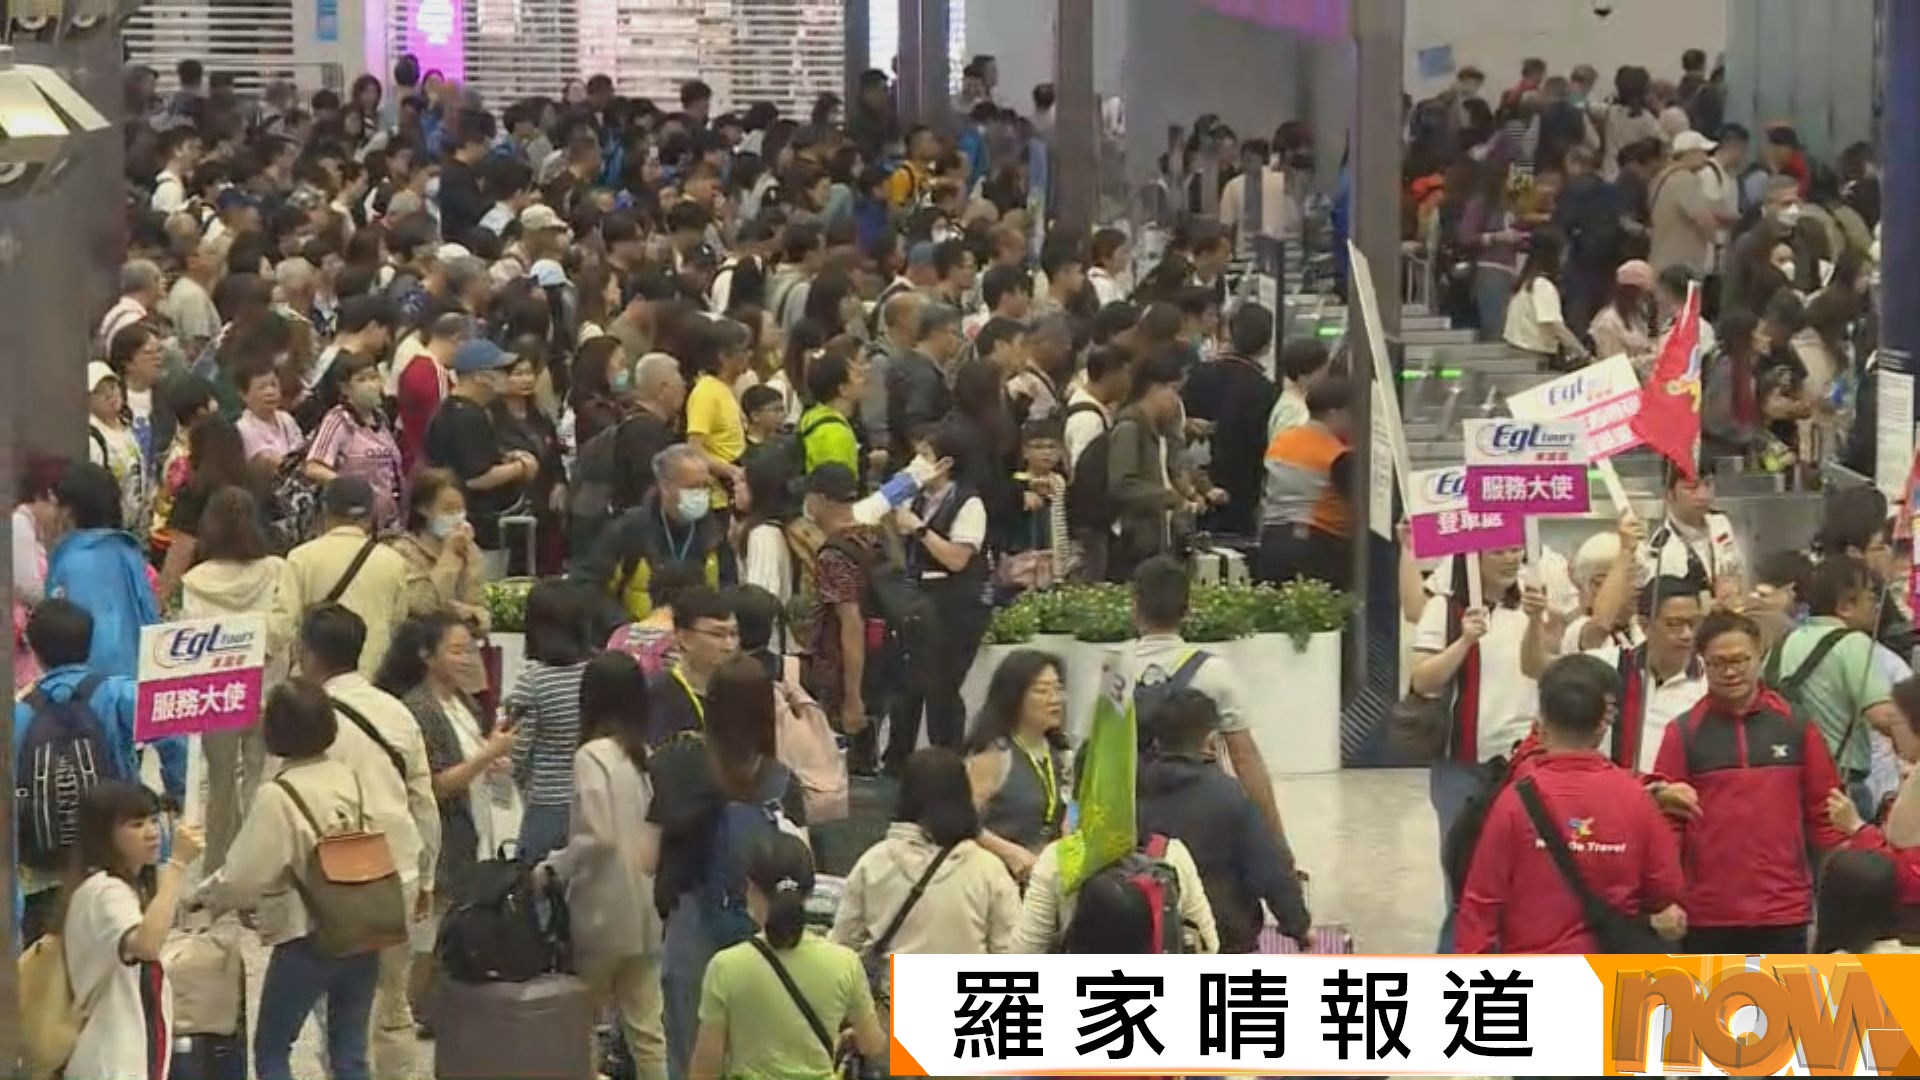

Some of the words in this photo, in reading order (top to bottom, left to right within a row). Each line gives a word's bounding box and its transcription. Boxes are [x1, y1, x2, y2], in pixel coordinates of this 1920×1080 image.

[1481, 475, 1574, 500] 服務大使
[151, 681, 247, 722] 服務大使
